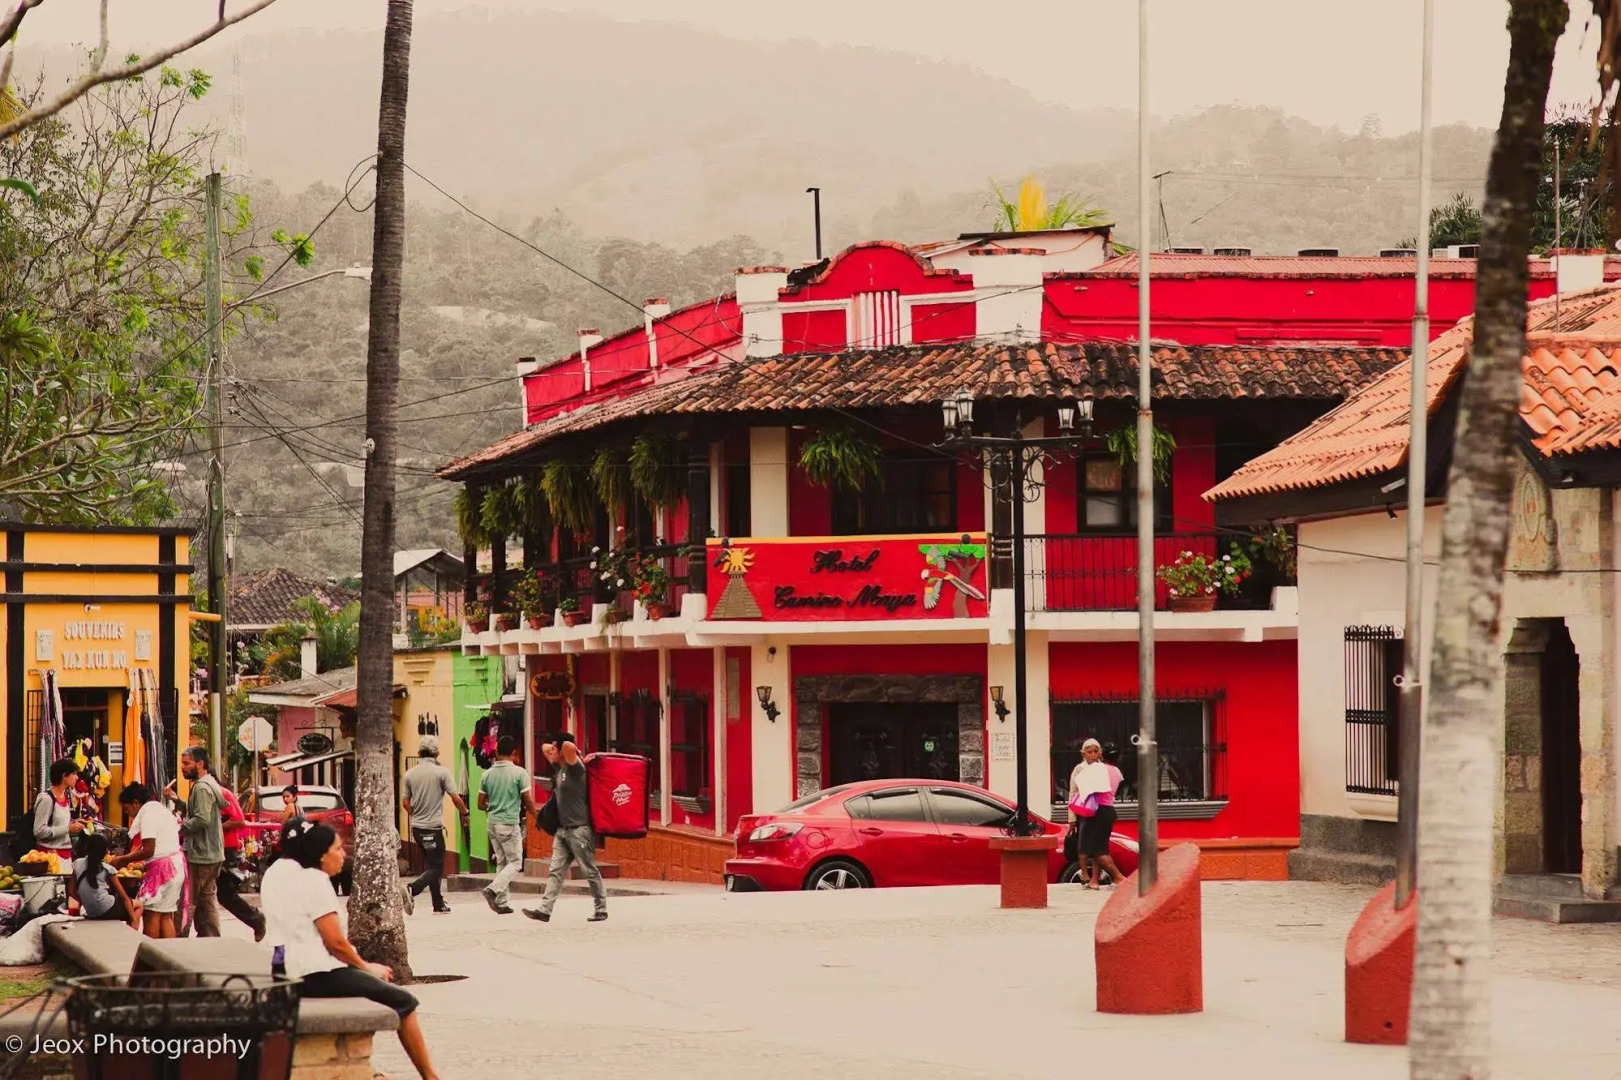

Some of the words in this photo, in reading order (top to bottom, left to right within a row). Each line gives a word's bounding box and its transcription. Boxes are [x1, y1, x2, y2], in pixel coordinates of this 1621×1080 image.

[810, 549, 880, 574] Hotel
[774, 585, 844, 610] Camino
[848, 584, 917, 612] Maya
[64, 621, 124, 639] SOUVENIRS
